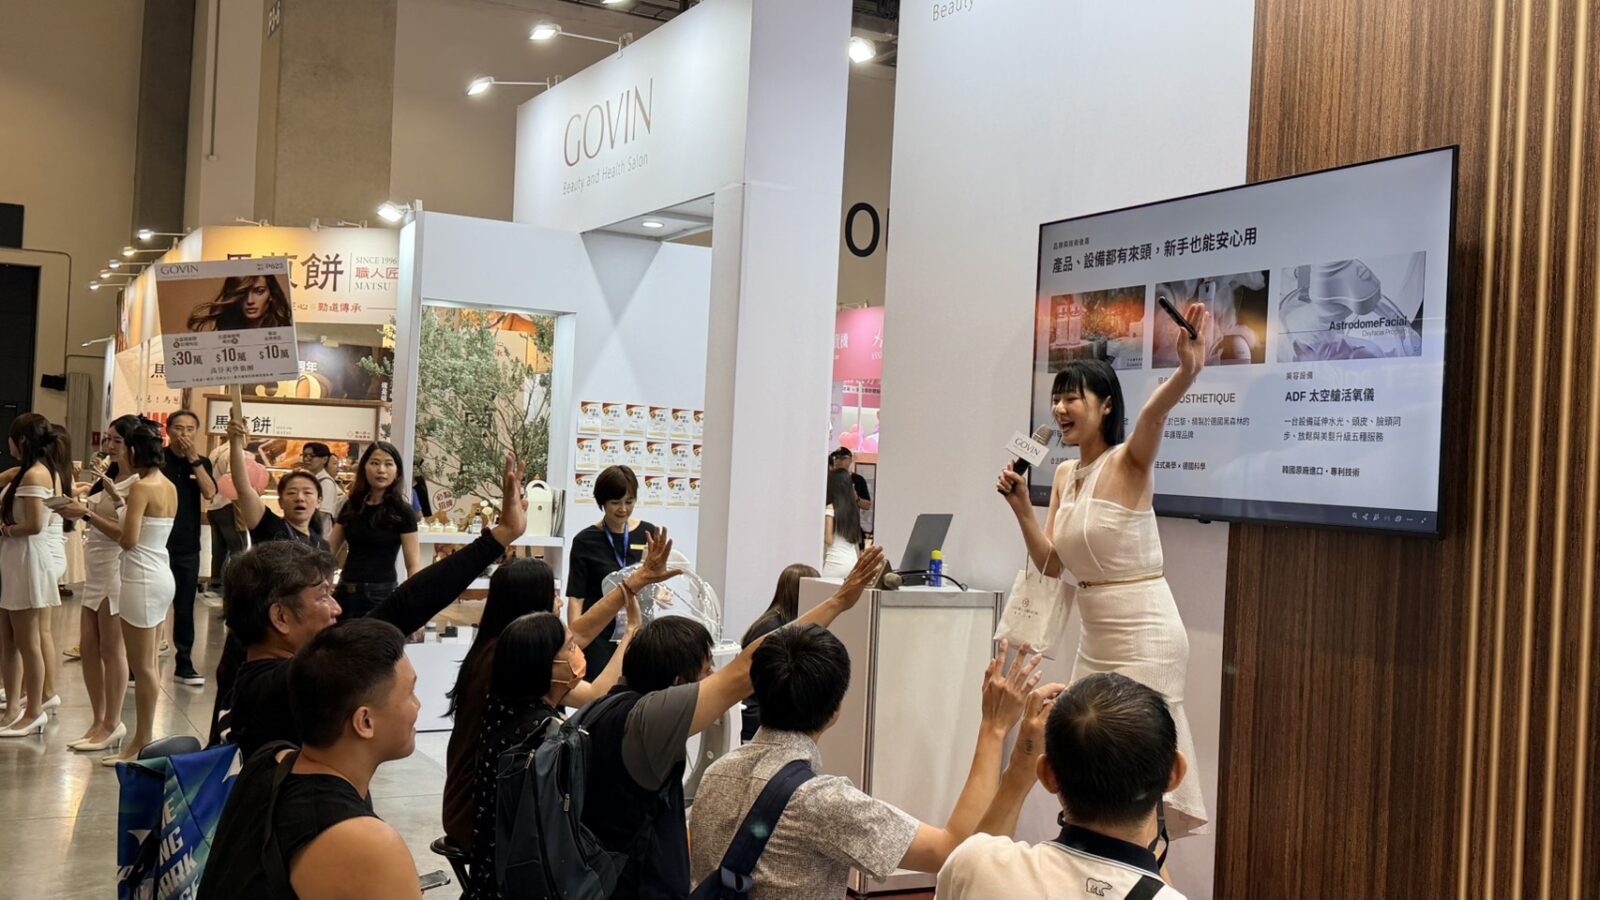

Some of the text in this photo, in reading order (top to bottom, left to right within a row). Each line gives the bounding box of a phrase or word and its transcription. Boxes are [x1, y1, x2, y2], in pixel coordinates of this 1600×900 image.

[564, 78, 653, 167] GOVIN
[563, 153, 648, 195] Beauty and Health Salon
[355, 256, 379, 265] SINCE
[161, 264, 199, 275] GOVIN
[354, 282, 391, 291] MATSU
[1329, 316, 1407, 331] AstrodomeFacial
[1285, 391, 1306, 402] ADF
[213, 415, 271, 434] 馬餅
[1014, 438, 1041, 456] GOVIN
